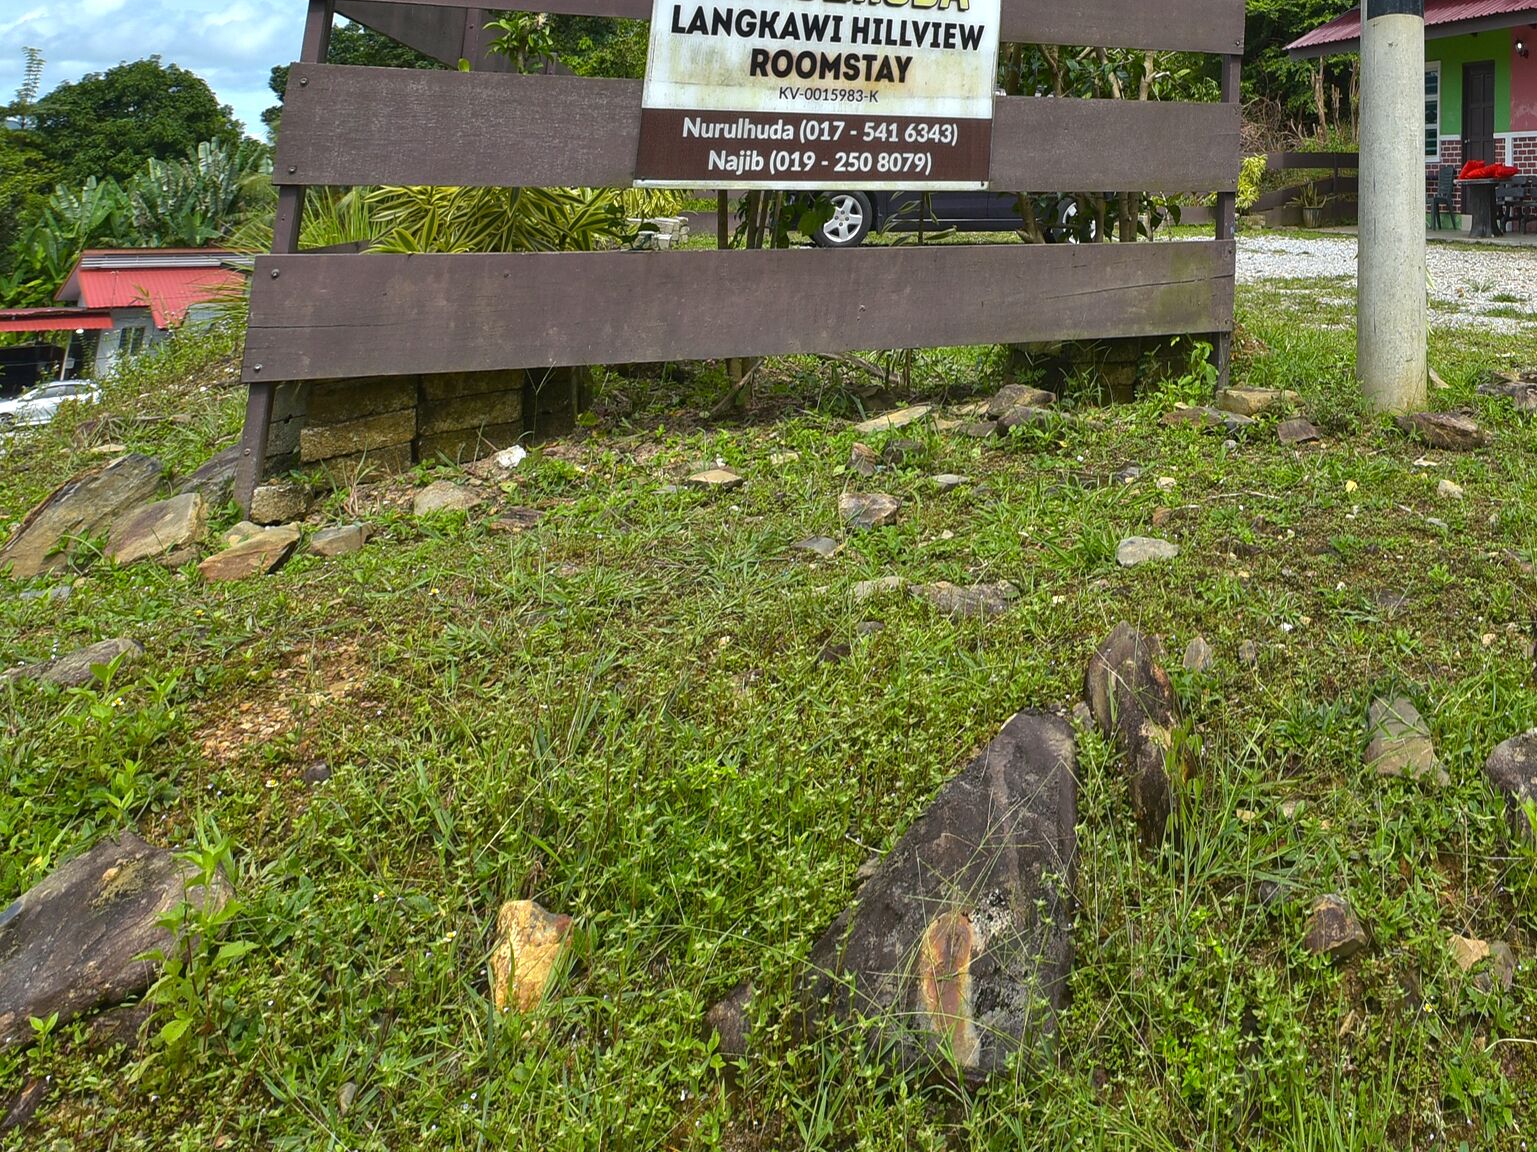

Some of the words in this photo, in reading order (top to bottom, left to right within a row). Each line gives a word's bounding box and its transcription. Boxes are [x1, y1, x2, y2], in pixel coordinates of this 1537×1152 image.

[671, 4, 842, 43] LANGKAWI
[850, 16, 985, 51] HILLVIEW
[750, 48, 914, 83] ROOMSTAY
[778, 86, 879, 103] KV-0015983-K
[682, 117, 794, 141] Nurulhuda
[800, 121, 844, 144] (017
[863, 123, 899, 142] 541
[904, 123, 959, 147] 6343)
[707, 150, 764, 175] Najib
[769, 151, 814, 174] (019
[835, 154, 872, 173] 250
[877, 154, 932, 175] 8079)
